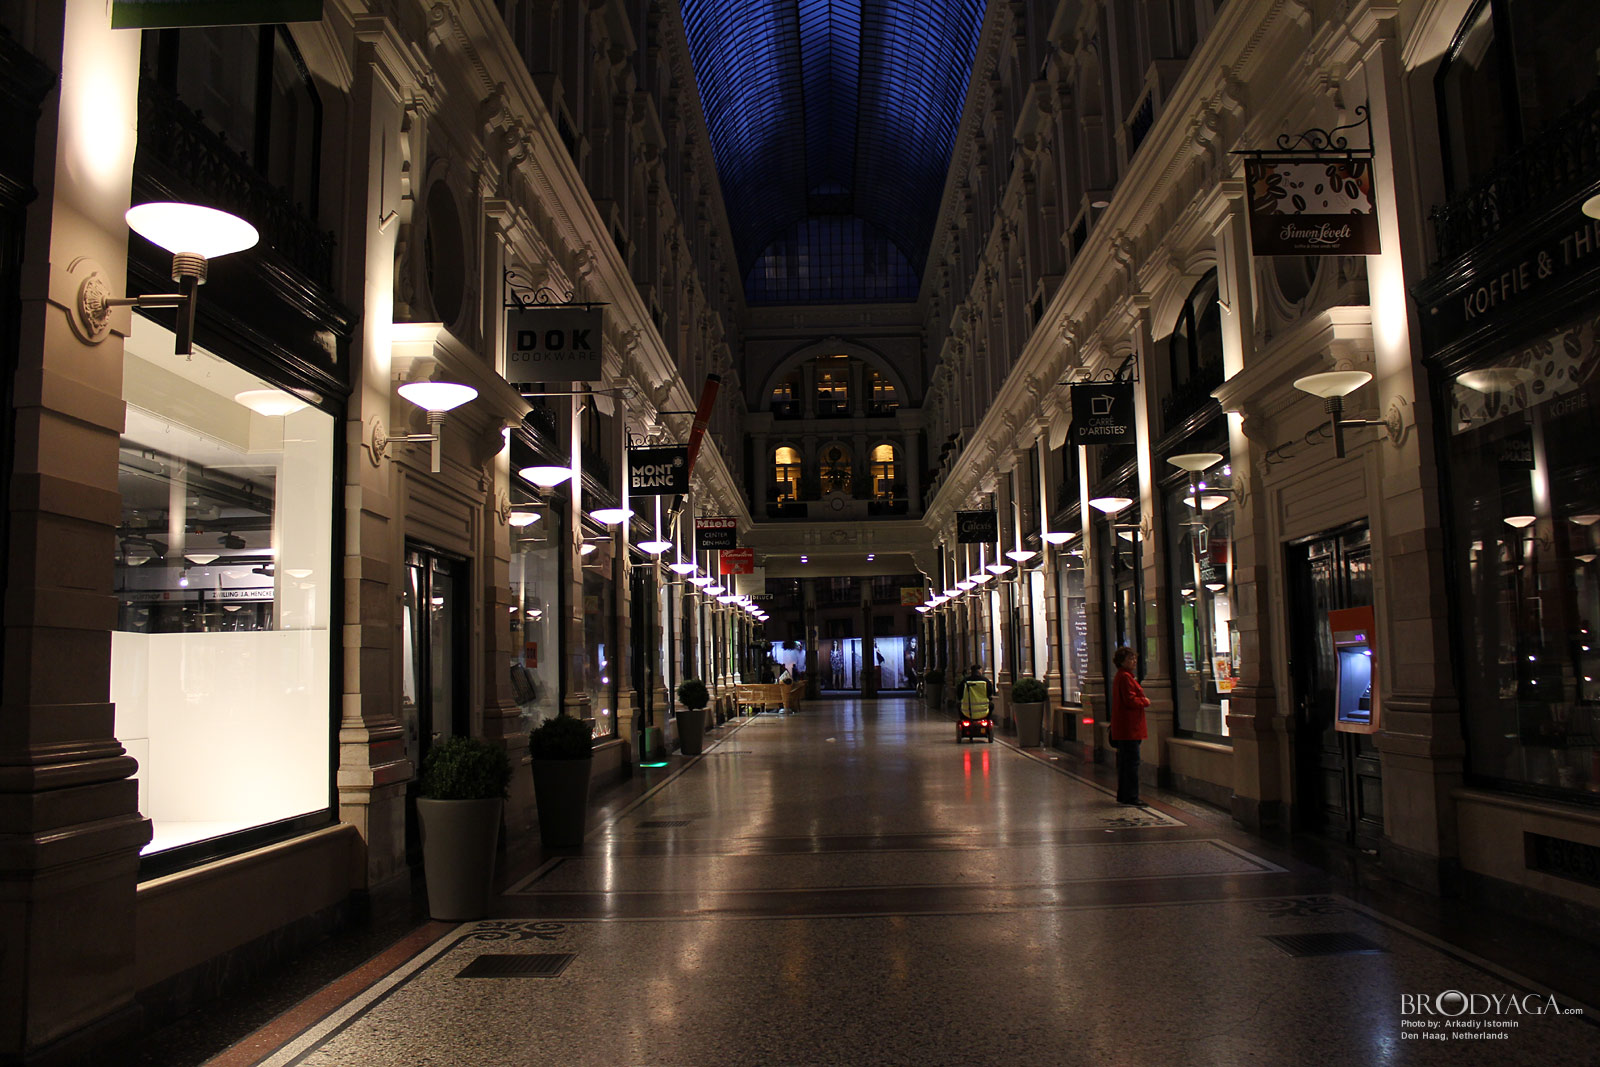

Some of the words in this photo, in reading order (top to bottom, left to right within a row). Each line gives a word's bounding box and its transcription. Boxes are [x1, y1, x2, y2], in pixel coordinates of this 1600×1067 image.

[1280, 223, 1319, 240] Simon
[1464, 261, 1531, 320] KOFFIE
[1538, 250, 1552, 279] &
[517, 329, 591, 351] DOK
[512, 352, 597, 362] COOKWARE
[632, 464, 673, 476] MONT
[632, 475, 674, 487] BLANC
[697, 520, 735, 528] Miele
